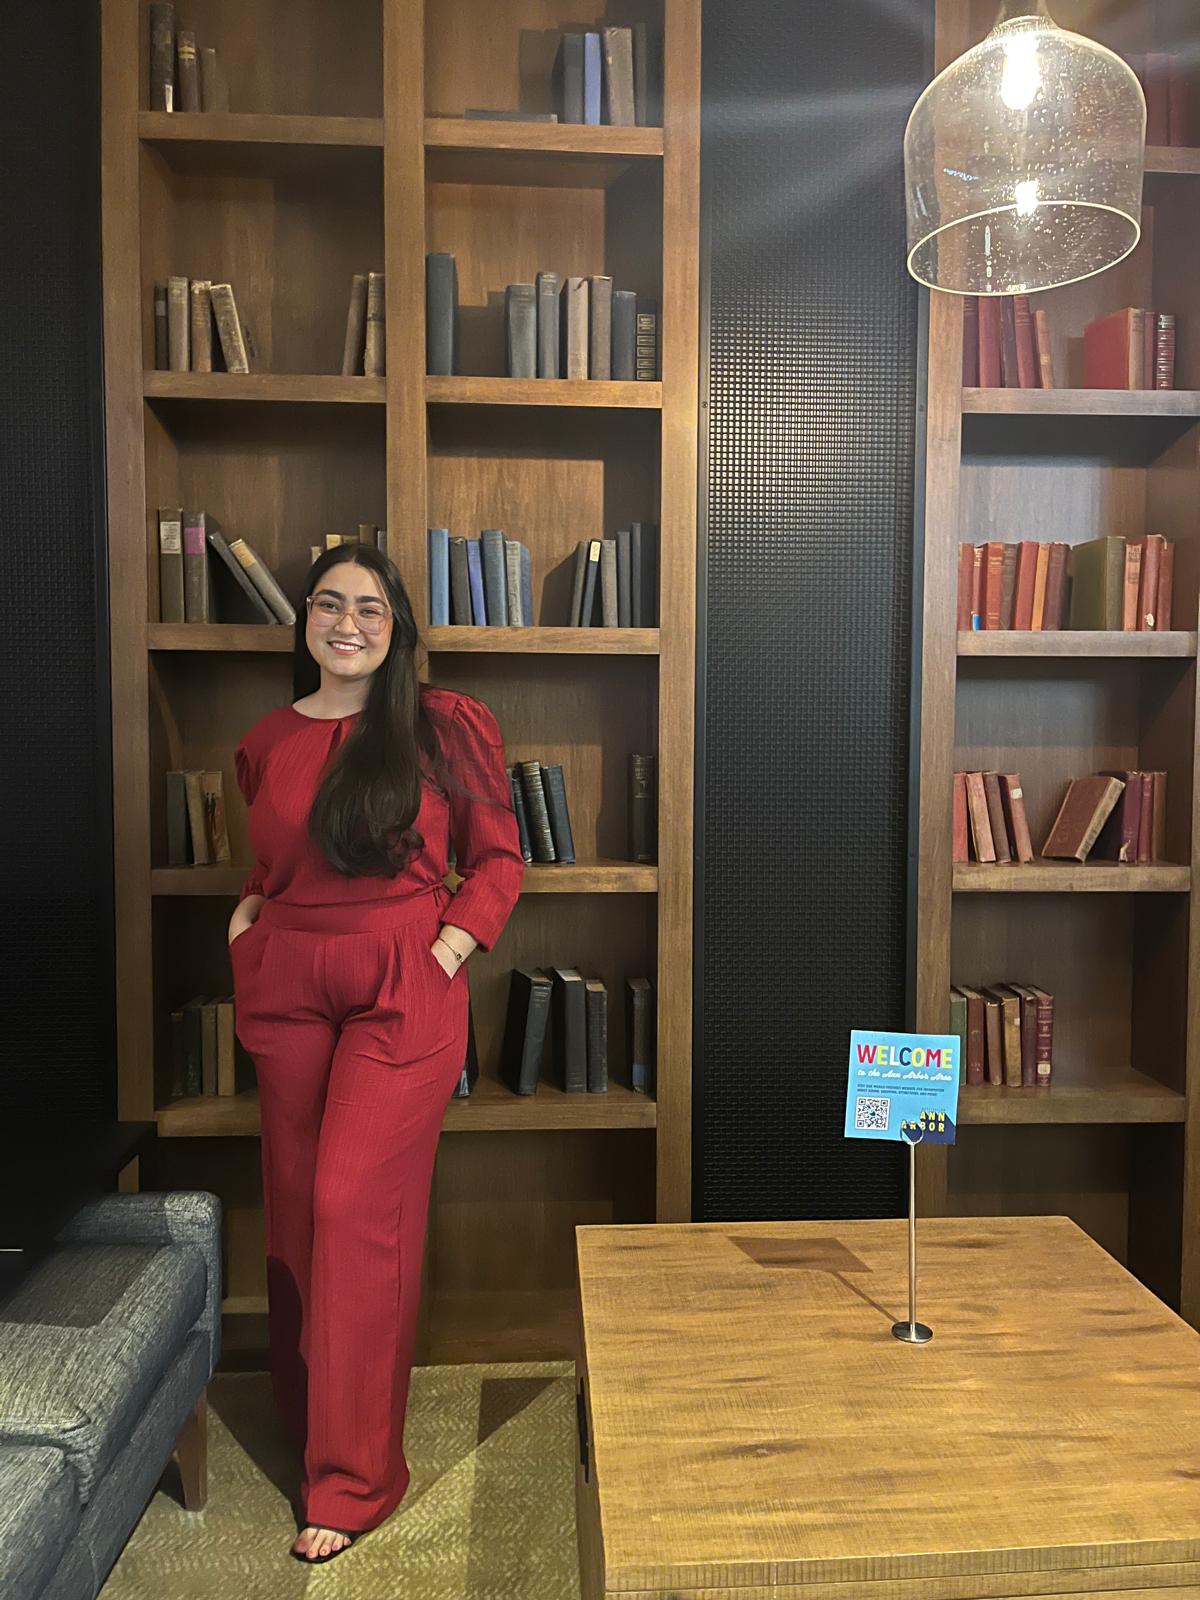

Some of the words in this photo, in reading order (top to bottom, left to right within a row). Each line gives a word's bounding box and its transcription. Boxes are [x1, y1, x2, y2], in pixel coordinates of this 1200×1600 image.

[857, 1044, 953, 1069] WELCOME
[868, 1068, 880, 1077] the
[882, 1069, 901, 1079] Ann
[902, 1070, 929, 1080] Arbor
[930, 1072, 953, 1081] Area
[920, 1111, 945, 1121] ANN
